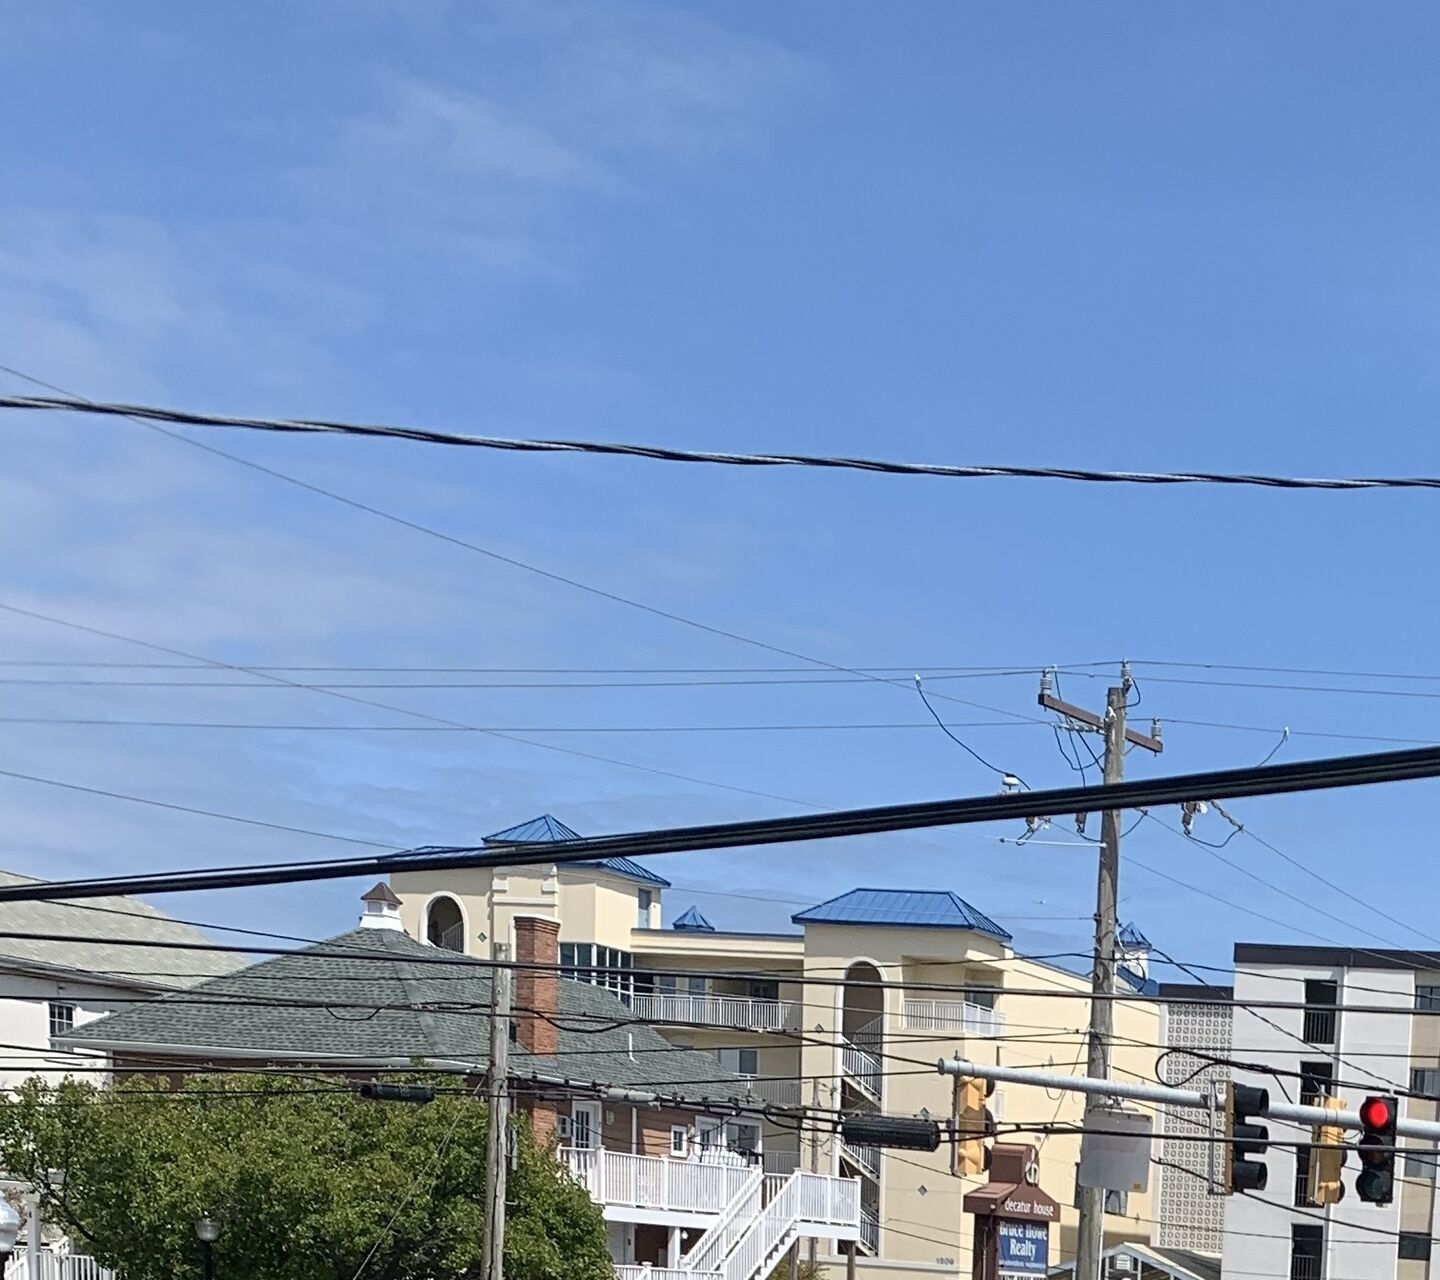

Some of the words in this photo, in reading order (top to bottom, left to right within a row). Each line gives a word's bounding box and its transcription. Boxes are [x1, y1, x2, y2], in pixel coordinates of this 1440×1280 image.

[1004, 1198, 1031, 1213] decatur
[1034, 1200, 1053, 1216] house
[1000, 1221, 1024, 1238] Bruce
[1010, 1238, 1037, 1261] Realty
